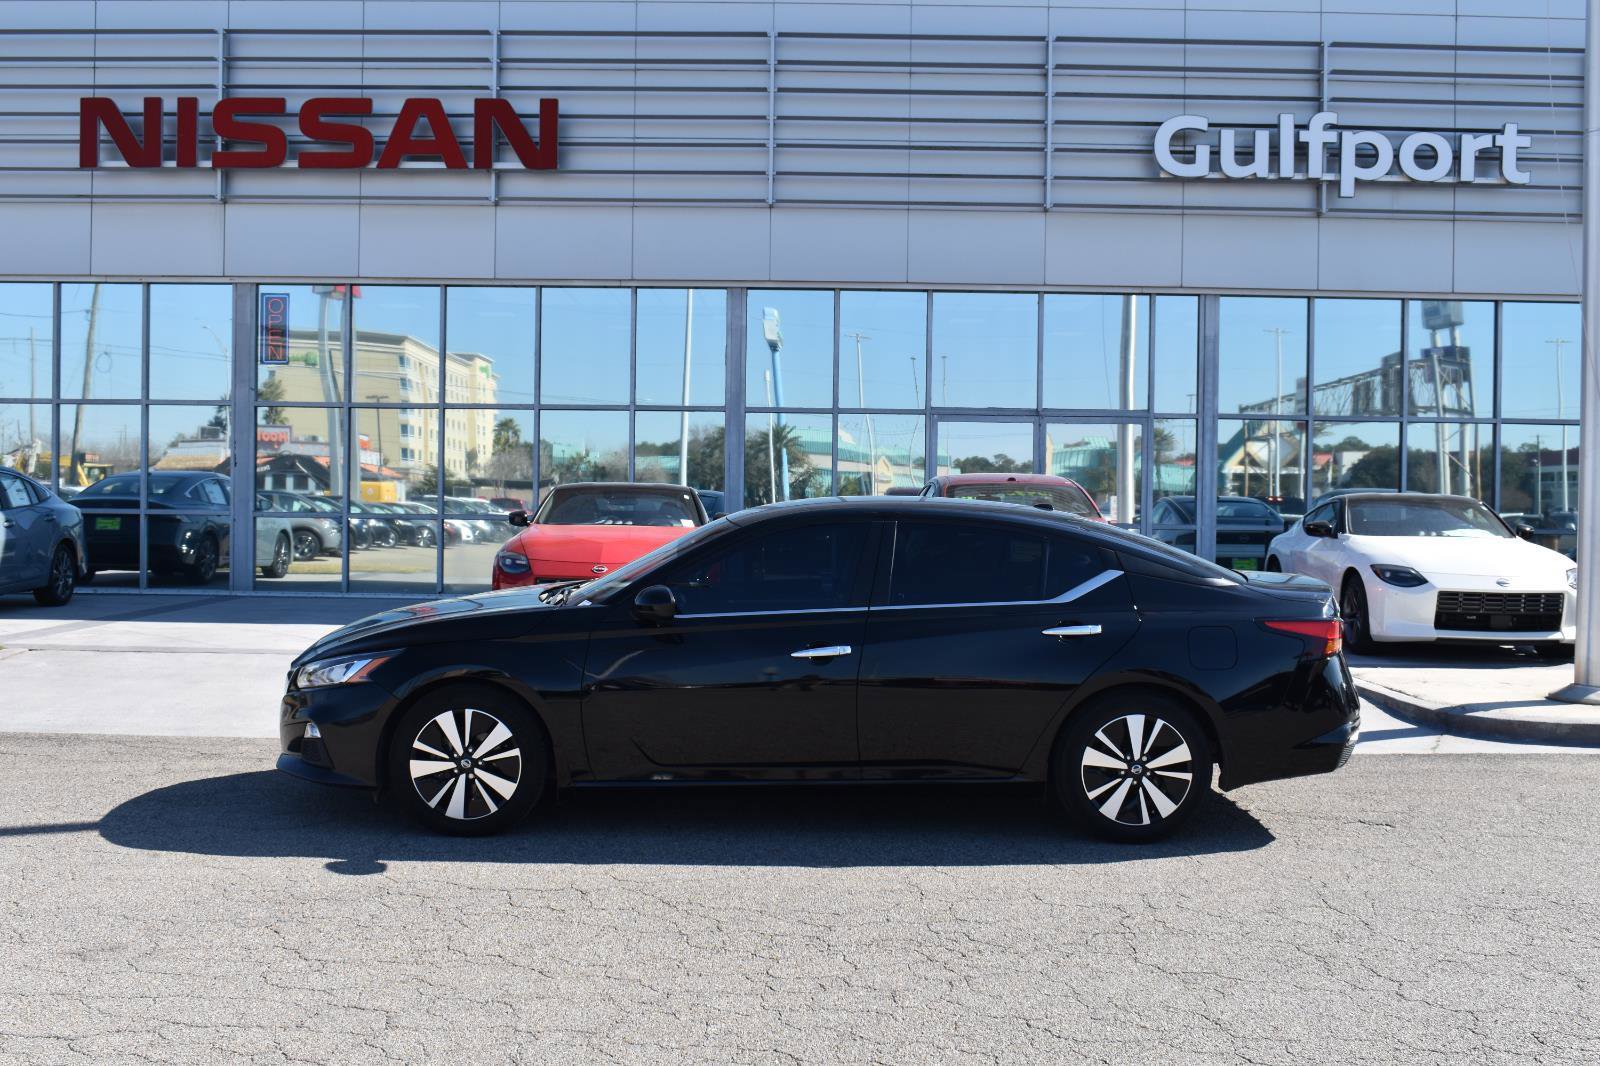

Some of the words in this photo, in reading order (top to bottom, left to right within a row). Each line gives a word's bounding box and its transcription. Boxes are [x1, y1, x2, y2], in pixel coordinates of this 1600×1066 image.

[79, 97, 559, 170] NISSAN
[1153, 111, 1533, 198] Gulfport
[268, 298, 284, 361] OPEN
